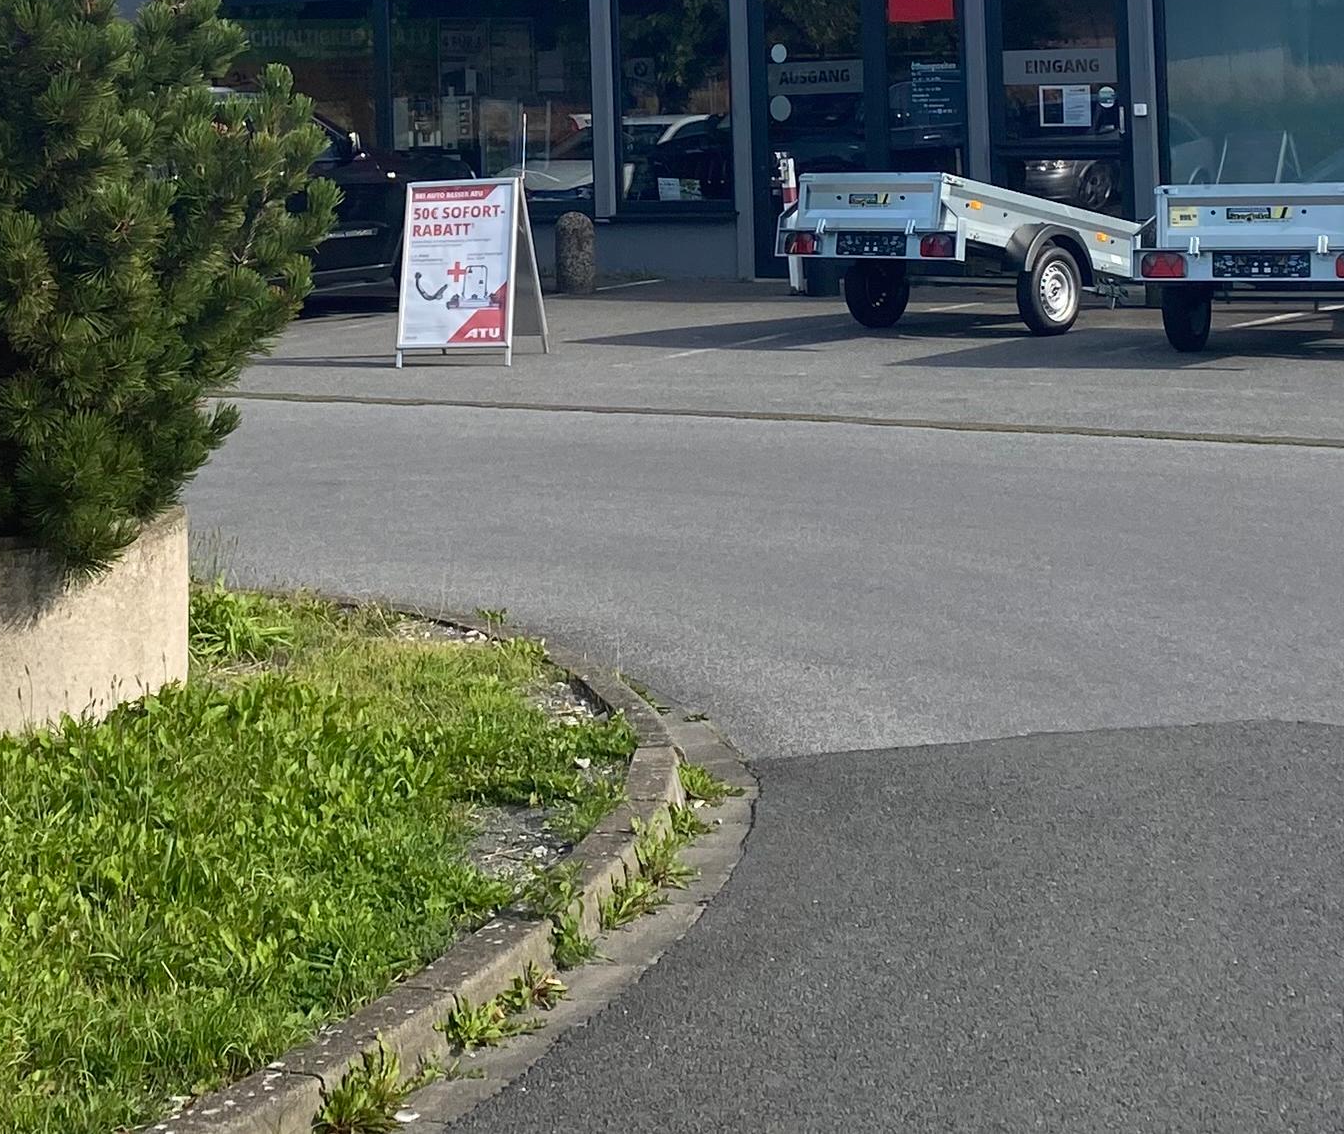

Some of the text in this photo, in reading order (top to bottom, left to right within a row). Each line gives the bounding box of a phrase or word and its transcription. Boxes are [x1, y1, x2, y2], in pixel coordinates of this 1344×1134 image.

[1025, 58, 1100, 74] EINGANG
[779, 69, 850, 85] AUSGANG
[413, 205, 506, 220] 50€ SOFORT-
[464, 327, 501, 339] ATU
